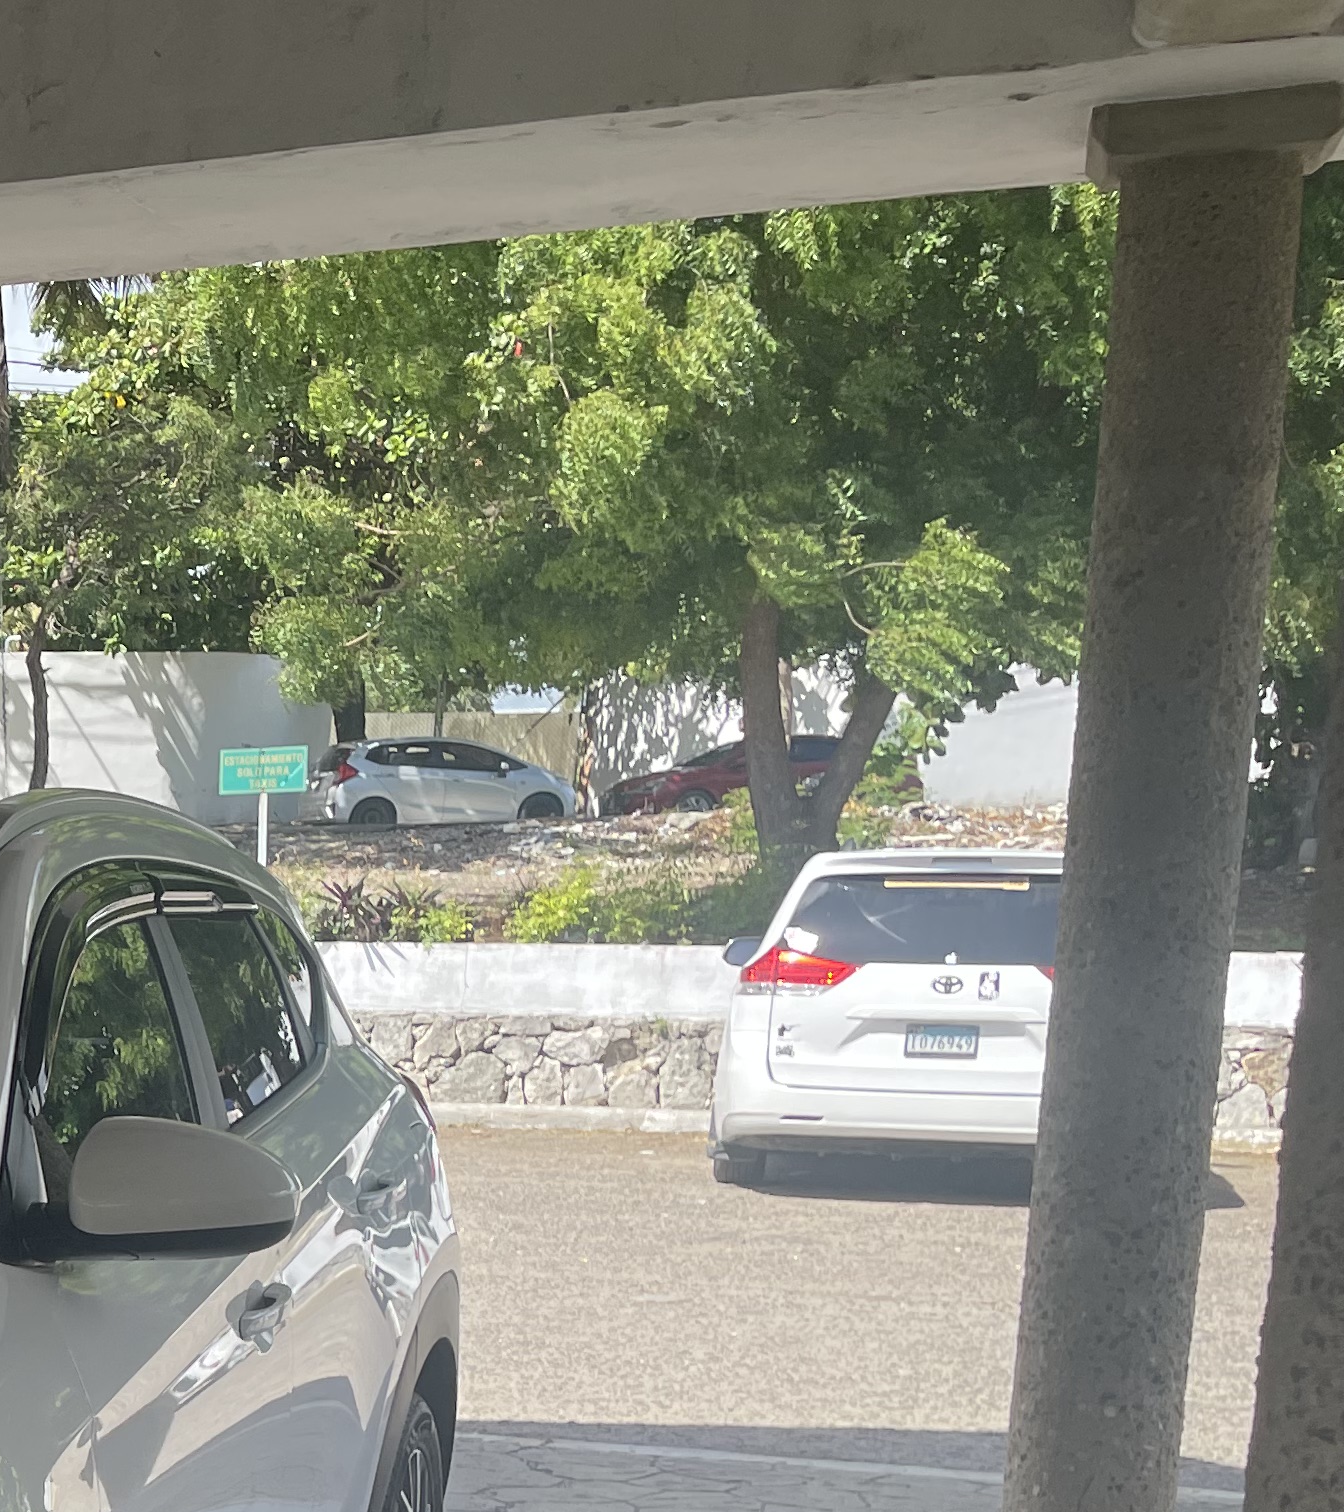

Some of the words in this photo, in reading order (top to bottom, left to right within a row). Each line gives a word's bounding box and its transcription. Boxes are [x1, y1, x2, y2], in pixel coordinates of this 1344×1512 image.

[224, 753, 303, 767] ESTACIONAMIENTO
[237, 767, 262, 777] SOLO
[264, 765, 290, 776] PARA
[249, 778, 278, 789] TAXIS
